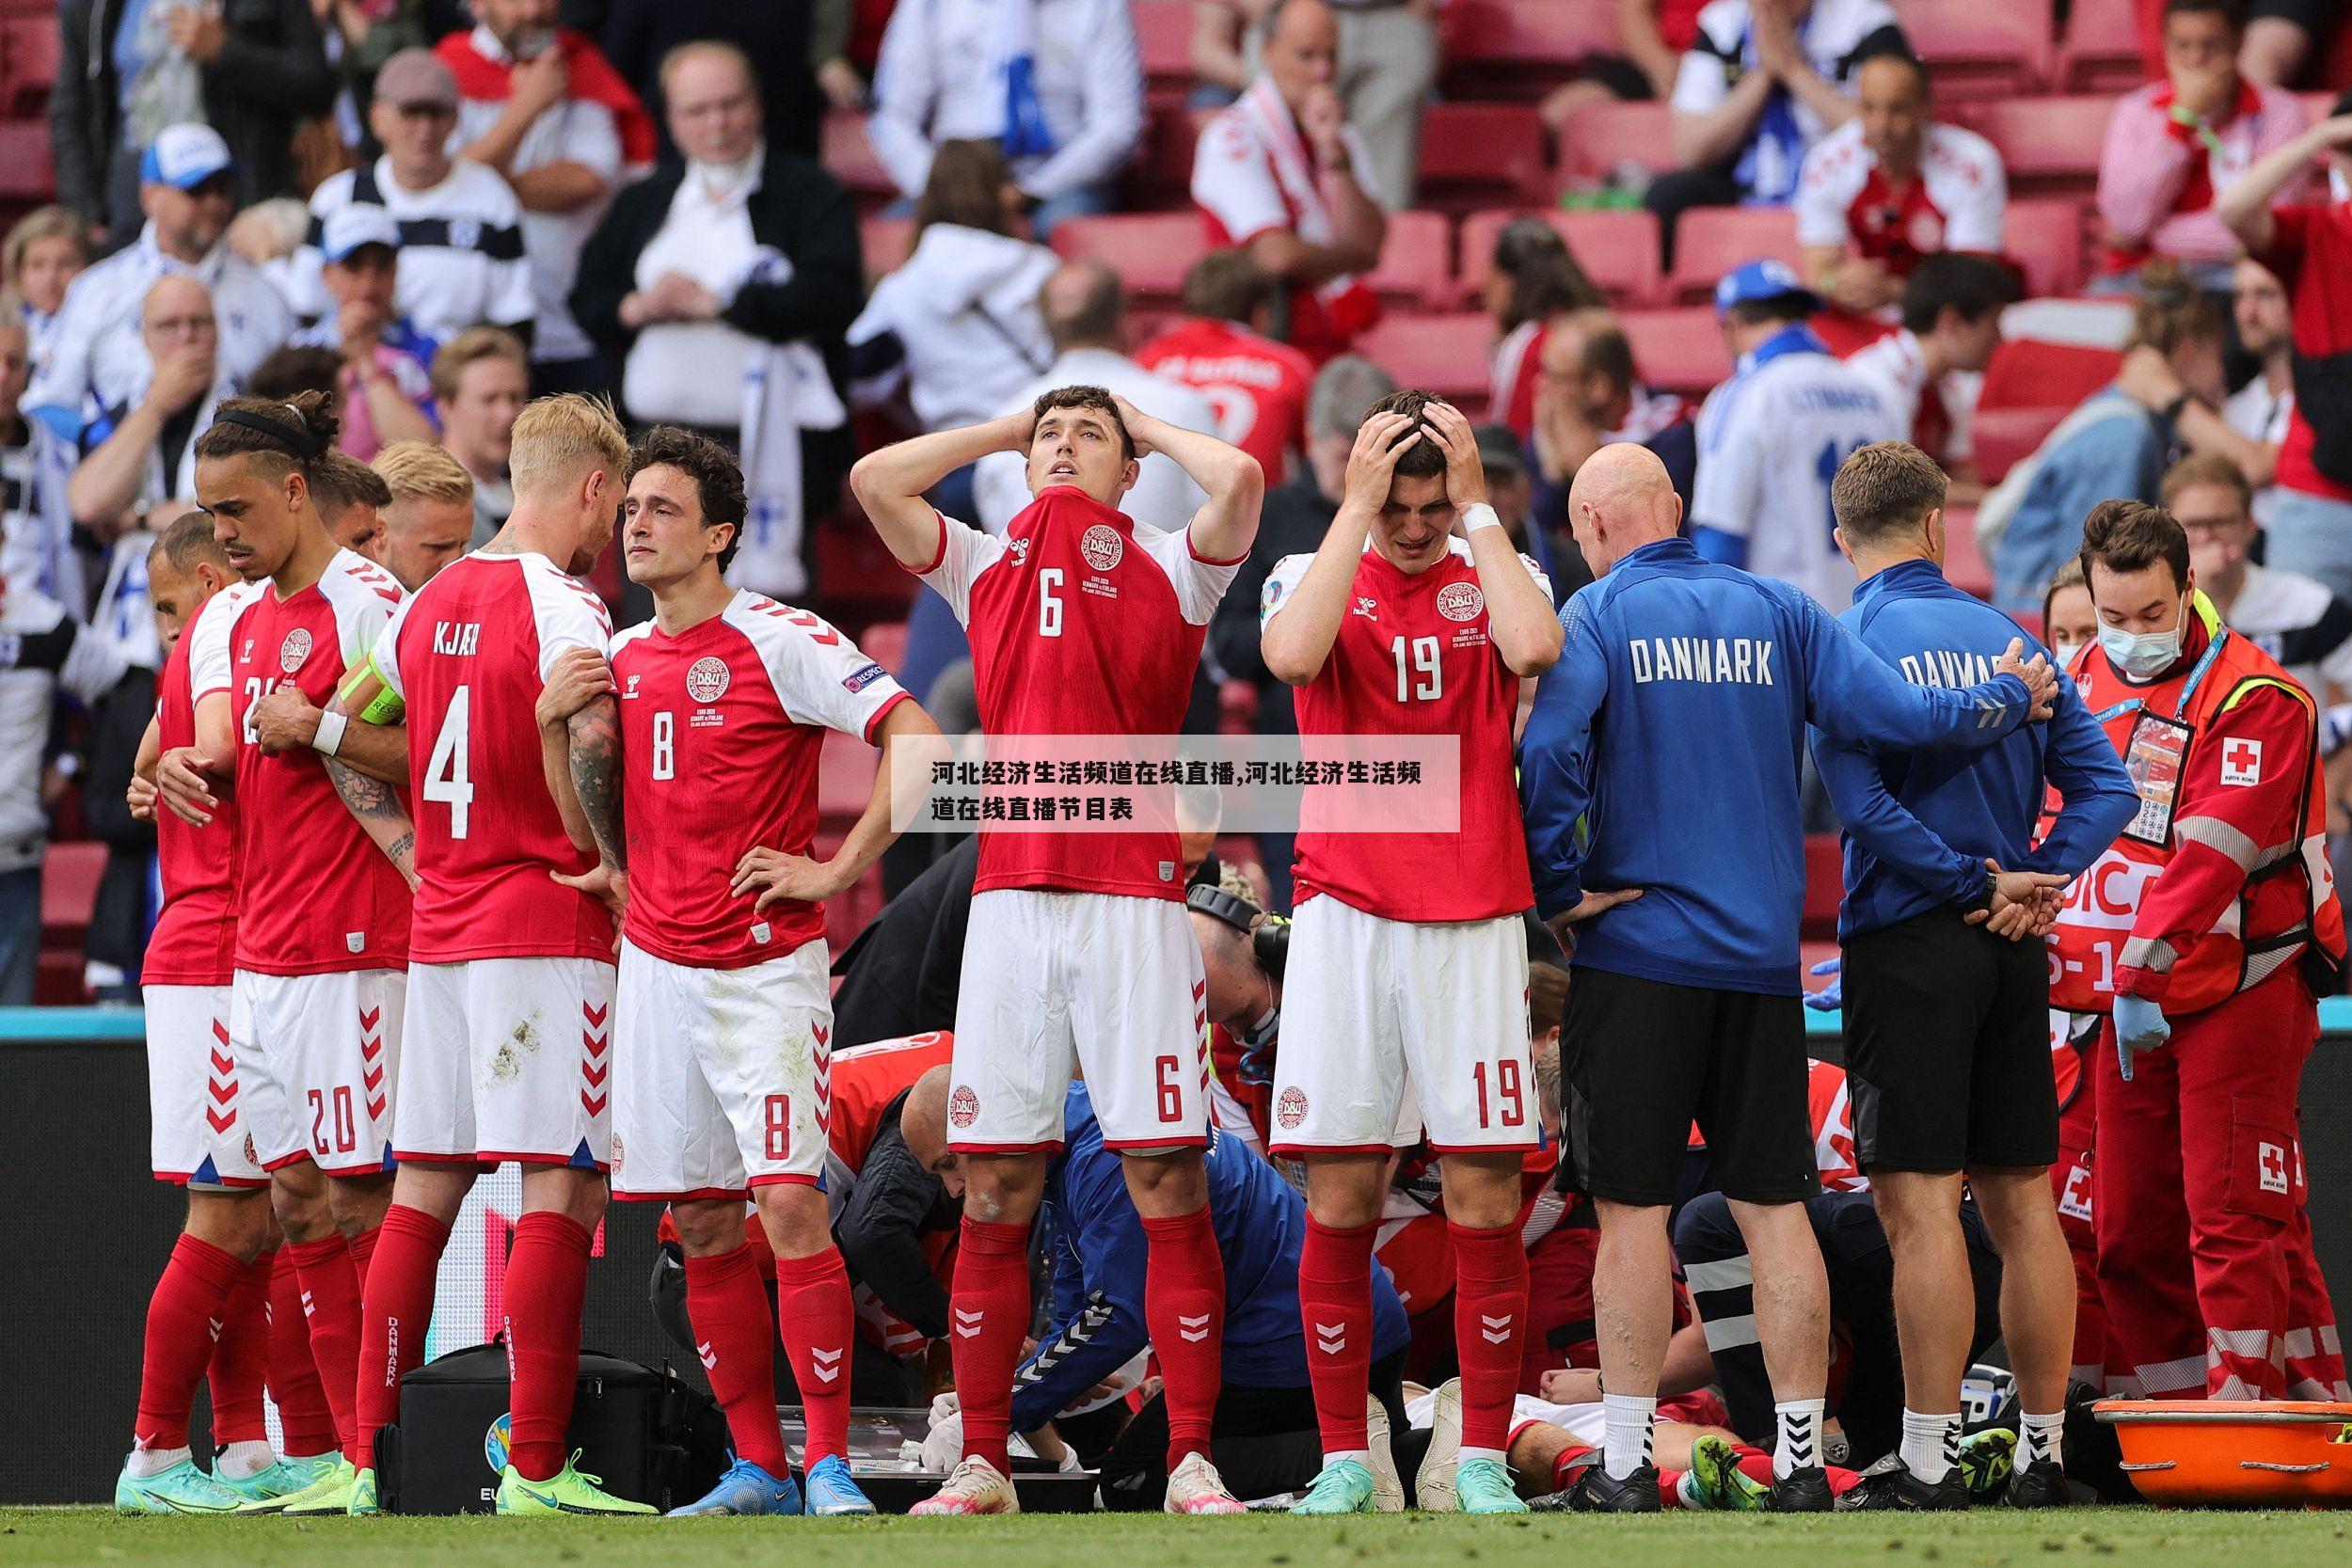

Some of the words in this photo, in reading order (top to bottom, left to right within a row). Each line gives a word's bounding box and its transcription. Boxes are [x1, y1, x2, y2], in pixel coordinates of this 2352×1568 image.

[1089, 539, 1114, 556] DBU
[1039, 567, 1064, 637] 6
[1447, 594, 1474, 609] DBU
[433, 621, 481, 657] KJÆR
[1391, 635, 1442, 703] 19
[1629, 637, 1773, 686] DANMARK
[1899, 650, 2025, 689] DANMA
[242, 676, 275, 745] 2
[696, 672, 721, 686] DBU
[422, 685, 474, 839] 4
[652, 711, 675, 781] 8
[308, 1085, 356, 1155] 20
[1155, 1055, 1184, 1123] 6
[1472, 1058, 1525, 1129] 19
[764, 1094, 790, 1161] 8
[386, 1316, 399, 1387] DANMARK
[503, 1315, 516, 1383] DANMARK
